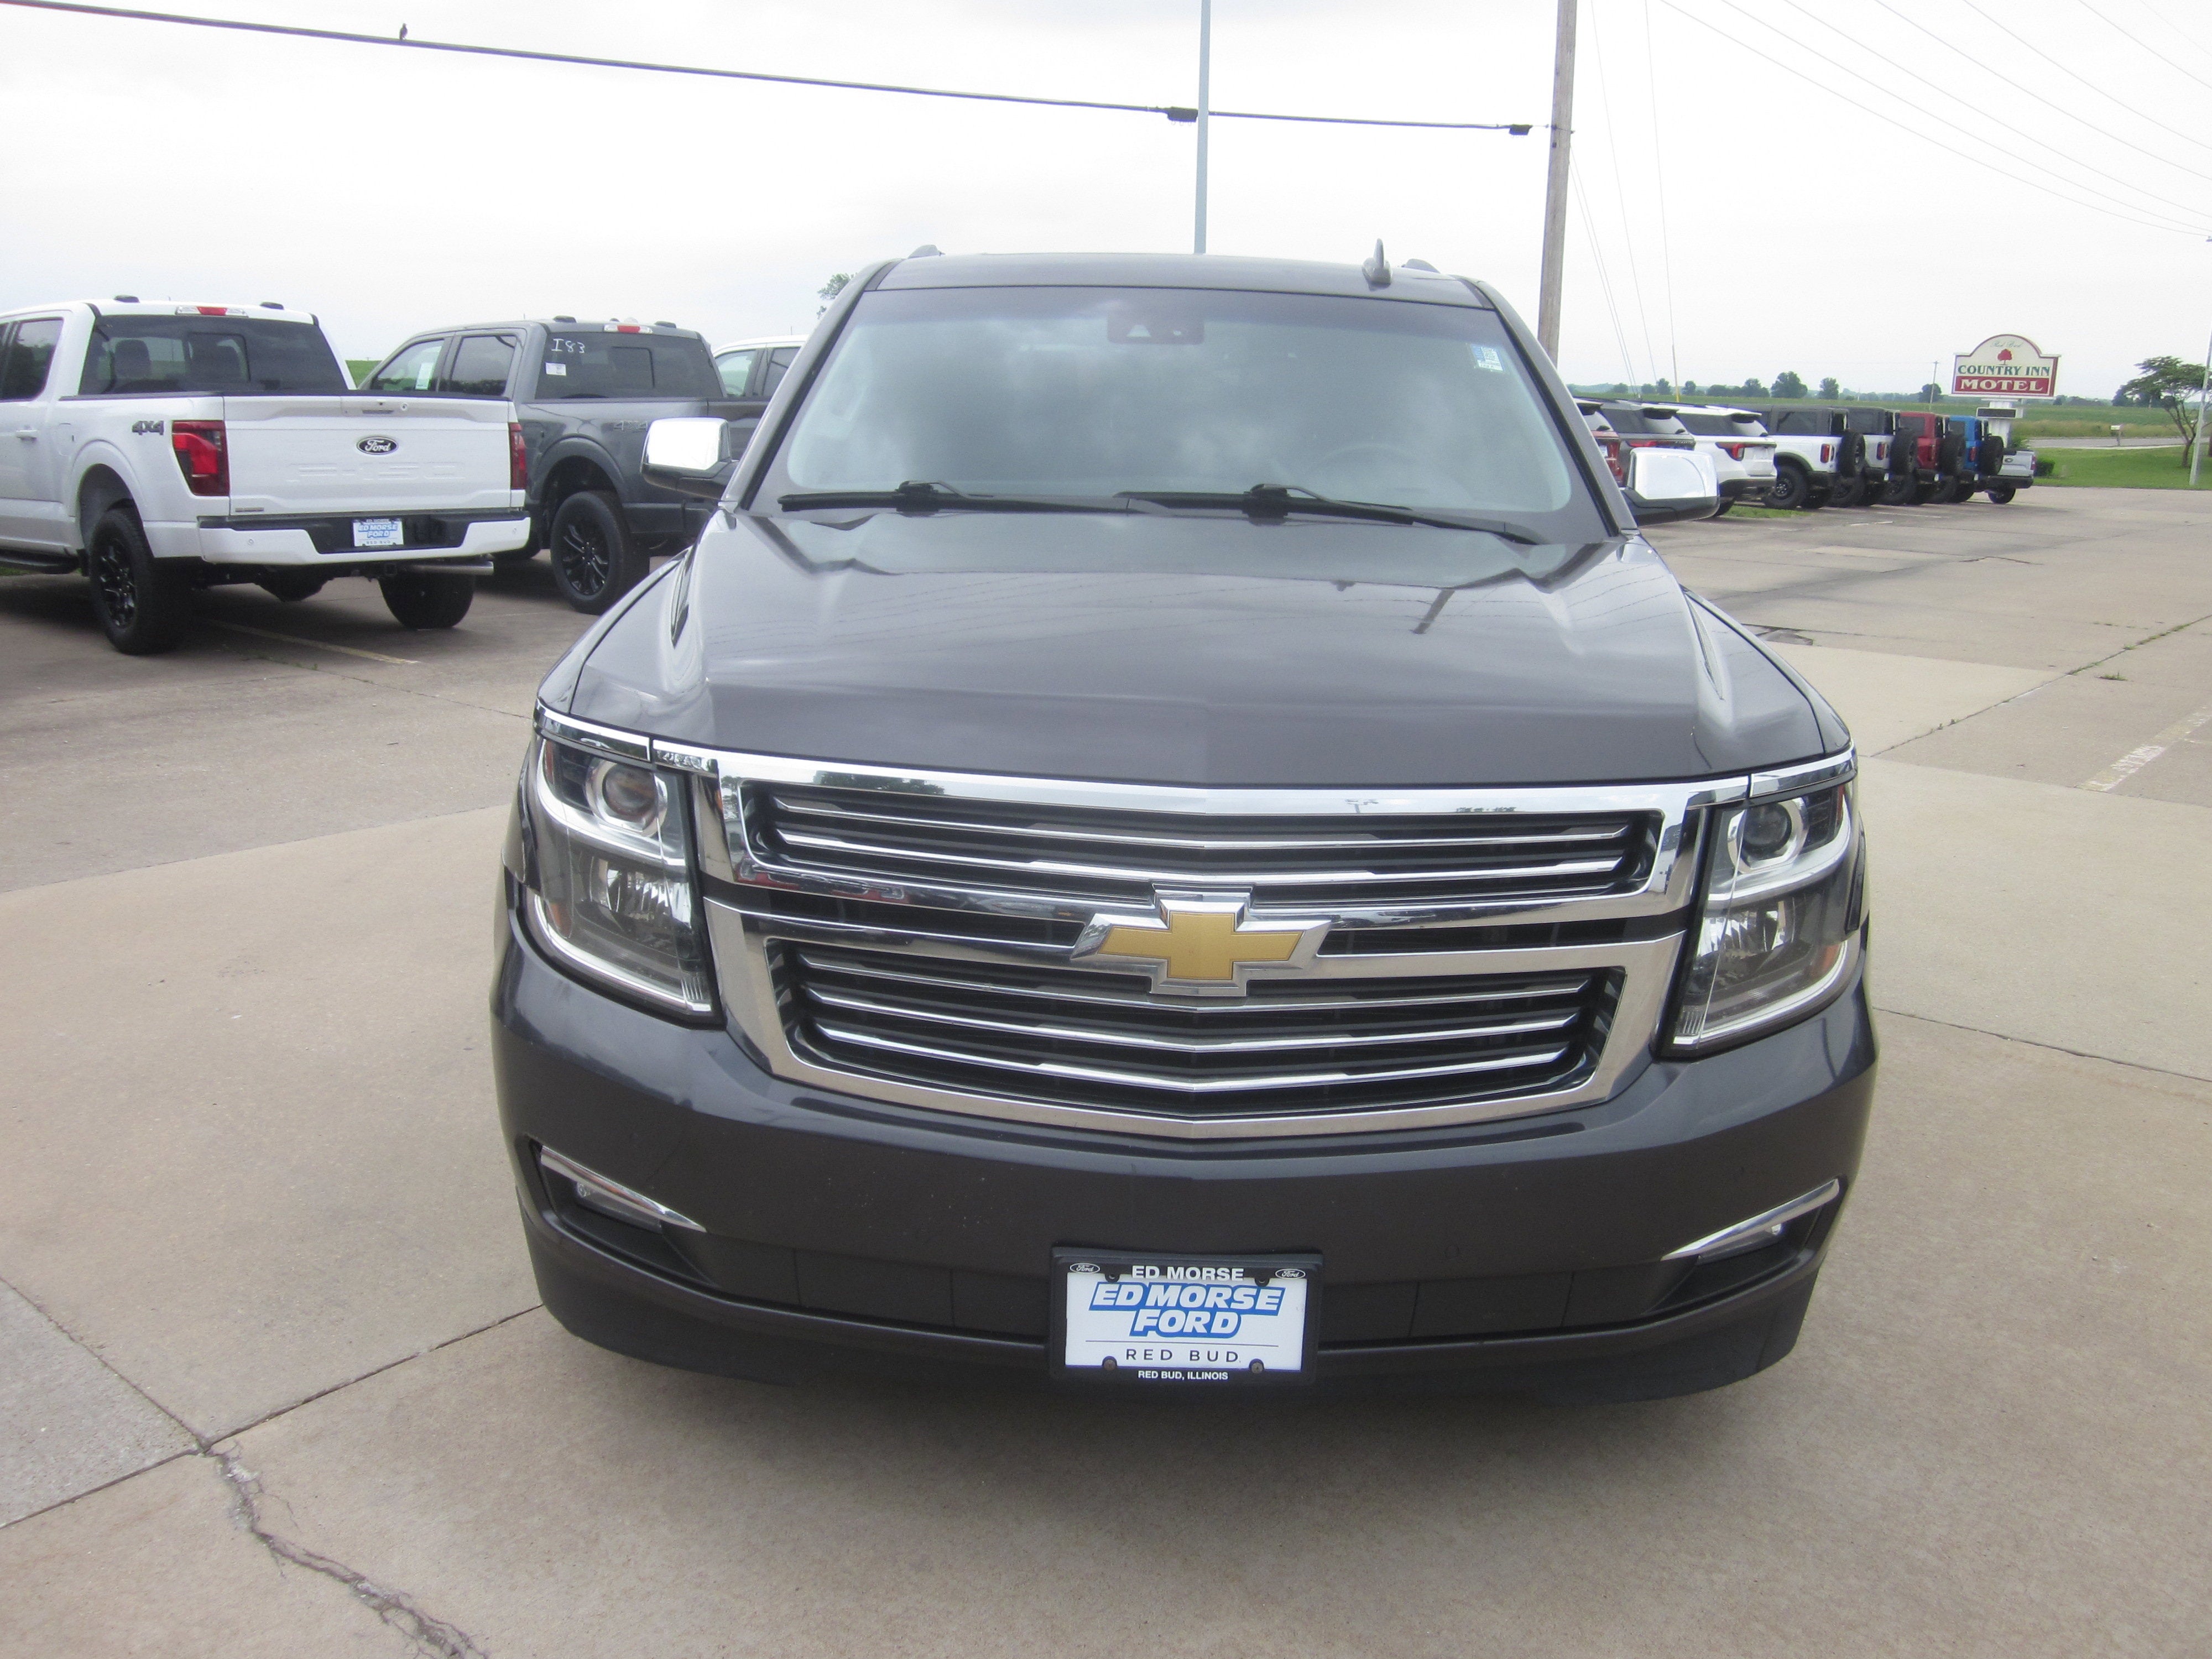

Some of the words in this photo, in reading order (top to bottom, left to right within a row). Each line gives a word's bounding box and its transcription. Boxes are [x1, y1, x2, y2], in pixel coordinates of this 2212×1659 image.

[1958, 365, 2022, 376] COUNTRY
[2026, 366, 2051, 377] INN
[1960, 379, 2043, 392] MOTEL
[364, 439, 392, 452] Ford
[369, 523, 398, 531] MORSE
[1076, 1264, 1094, 1272] Ford
[1131, 1265, 1160, 1279] ED
[1166, 1266, 1244, 1282] MORSE
[1281, 1270, 1300, 1278] Ford
[1092, 1283, 1144, 1307] ED
[1145, 1284, 1283, 1311] MORSE
[1133, 1308, 1239, 1334] FORD
[1126, 1348, 1173, 1361] RED
[1189, 1350, 1239, 1363] BUD
[1138, 1370, 1159, 1379] RED
[1161, 1371, 1185, 1380] BUD,
[1187, 1371, 1229, 1380] ILLINOIS
